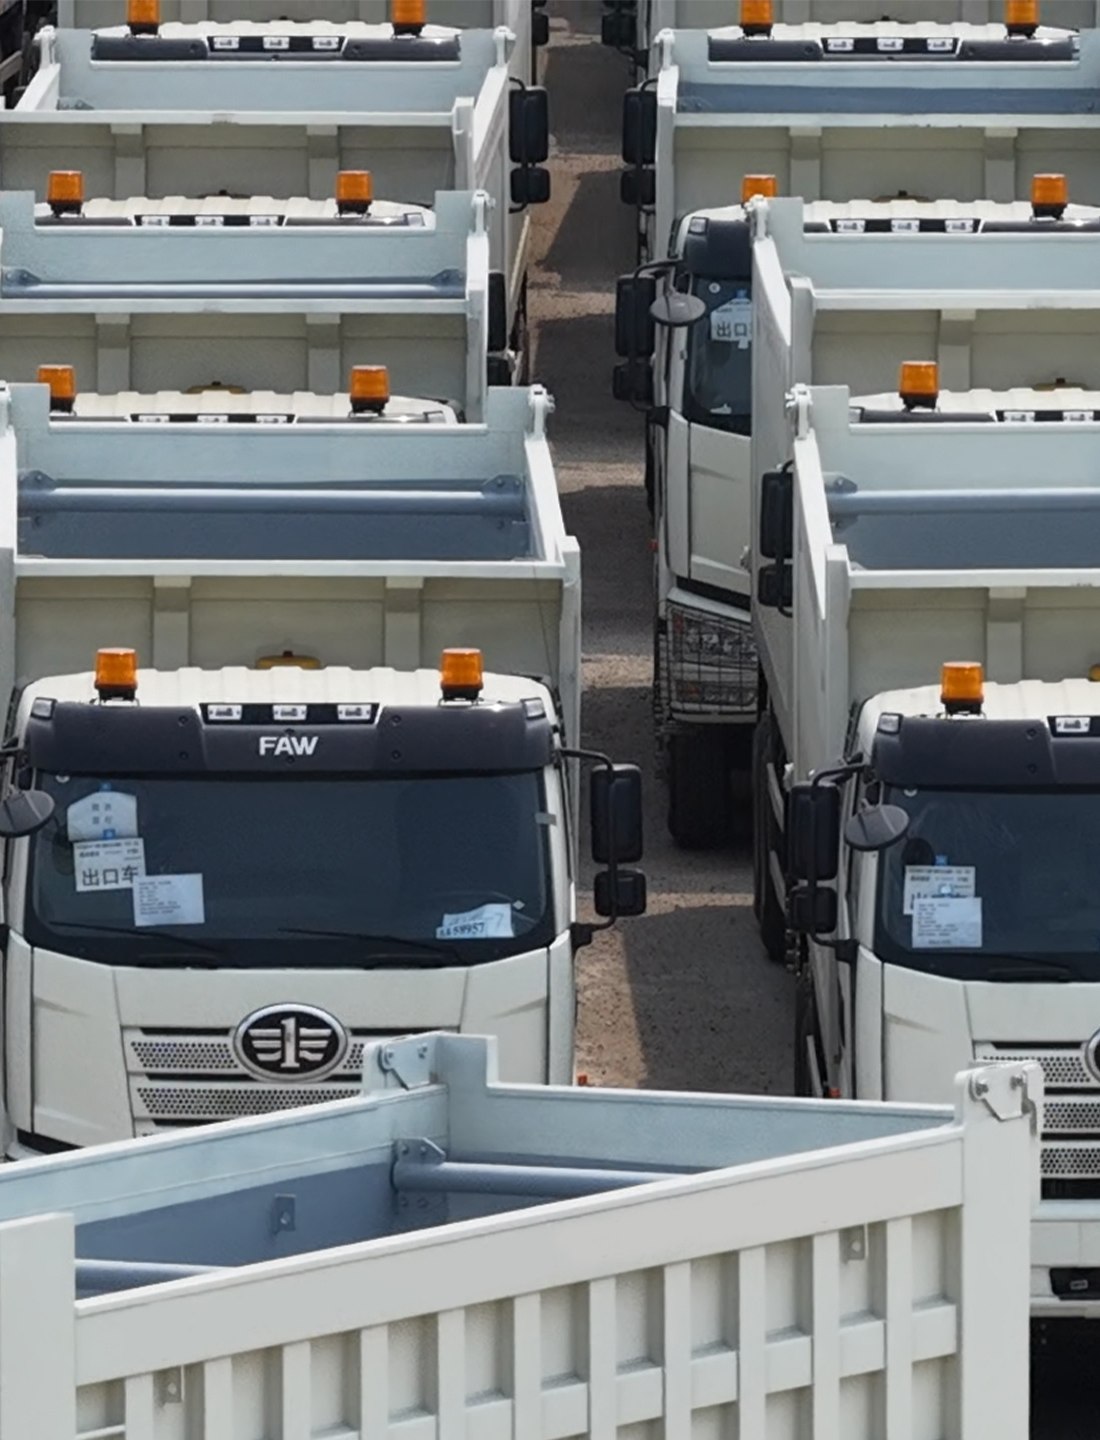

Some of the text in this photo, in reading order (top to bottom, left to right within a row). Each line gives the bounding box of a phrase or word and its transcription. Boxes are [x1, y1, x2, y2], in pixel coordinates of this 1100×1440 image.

[716, 321, 752, 338] 出口
[259, 736, 319, 755] FAW
[82, 865, 139, 886] 出口车
